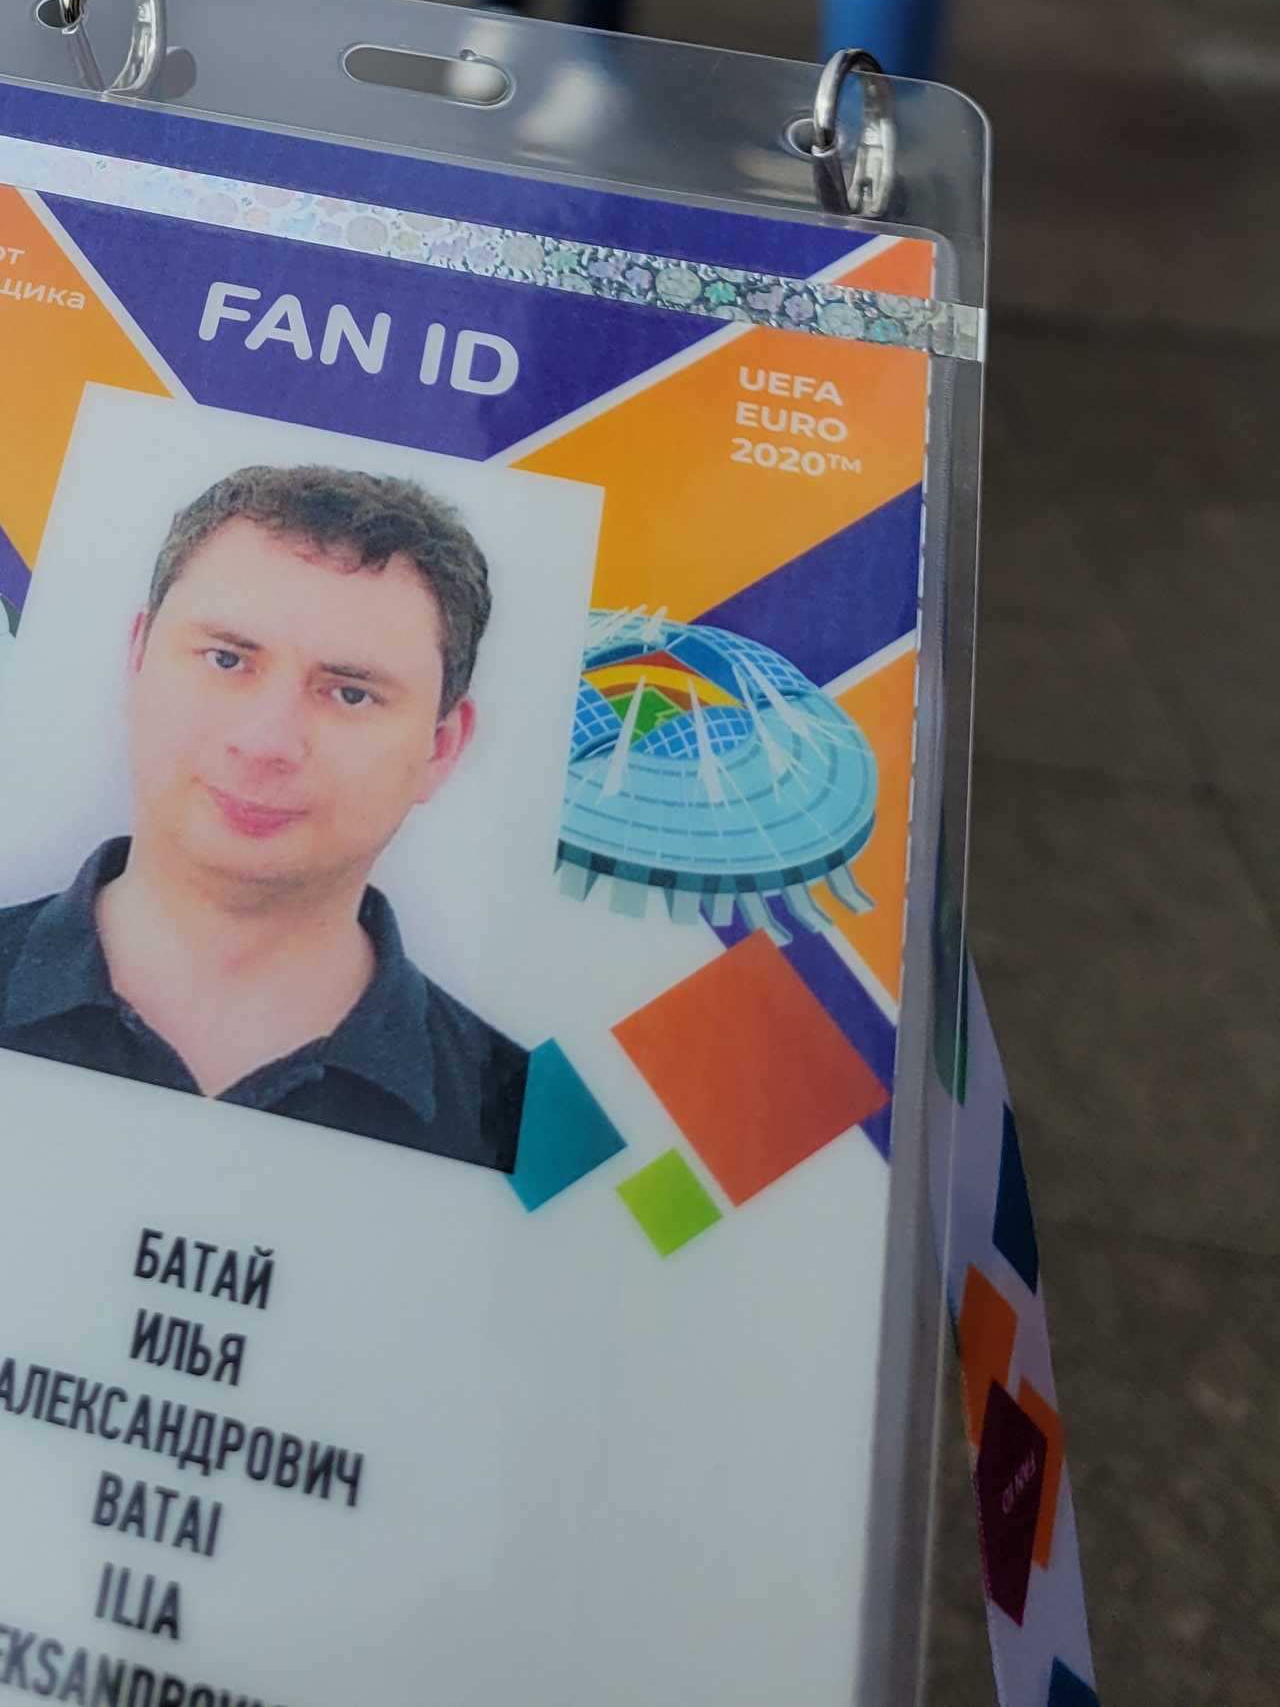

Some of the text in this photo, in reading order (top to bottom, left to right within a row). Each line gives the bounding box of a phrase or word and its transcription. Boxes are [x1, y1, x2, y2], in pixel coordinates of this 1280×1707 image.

[197, 280, 519, 397] FAN ID
[734, 401, 849, 445] EURO
[737, 365, 844, 409] UEFA
[132, 1227, 275, 1310] БАТАЙ
[129, 1307, 247, 1387] ИЛЬЯ
[91, 1469, 223, 1557] BATAI
[94, 1561, 181, 1640] ILIA
